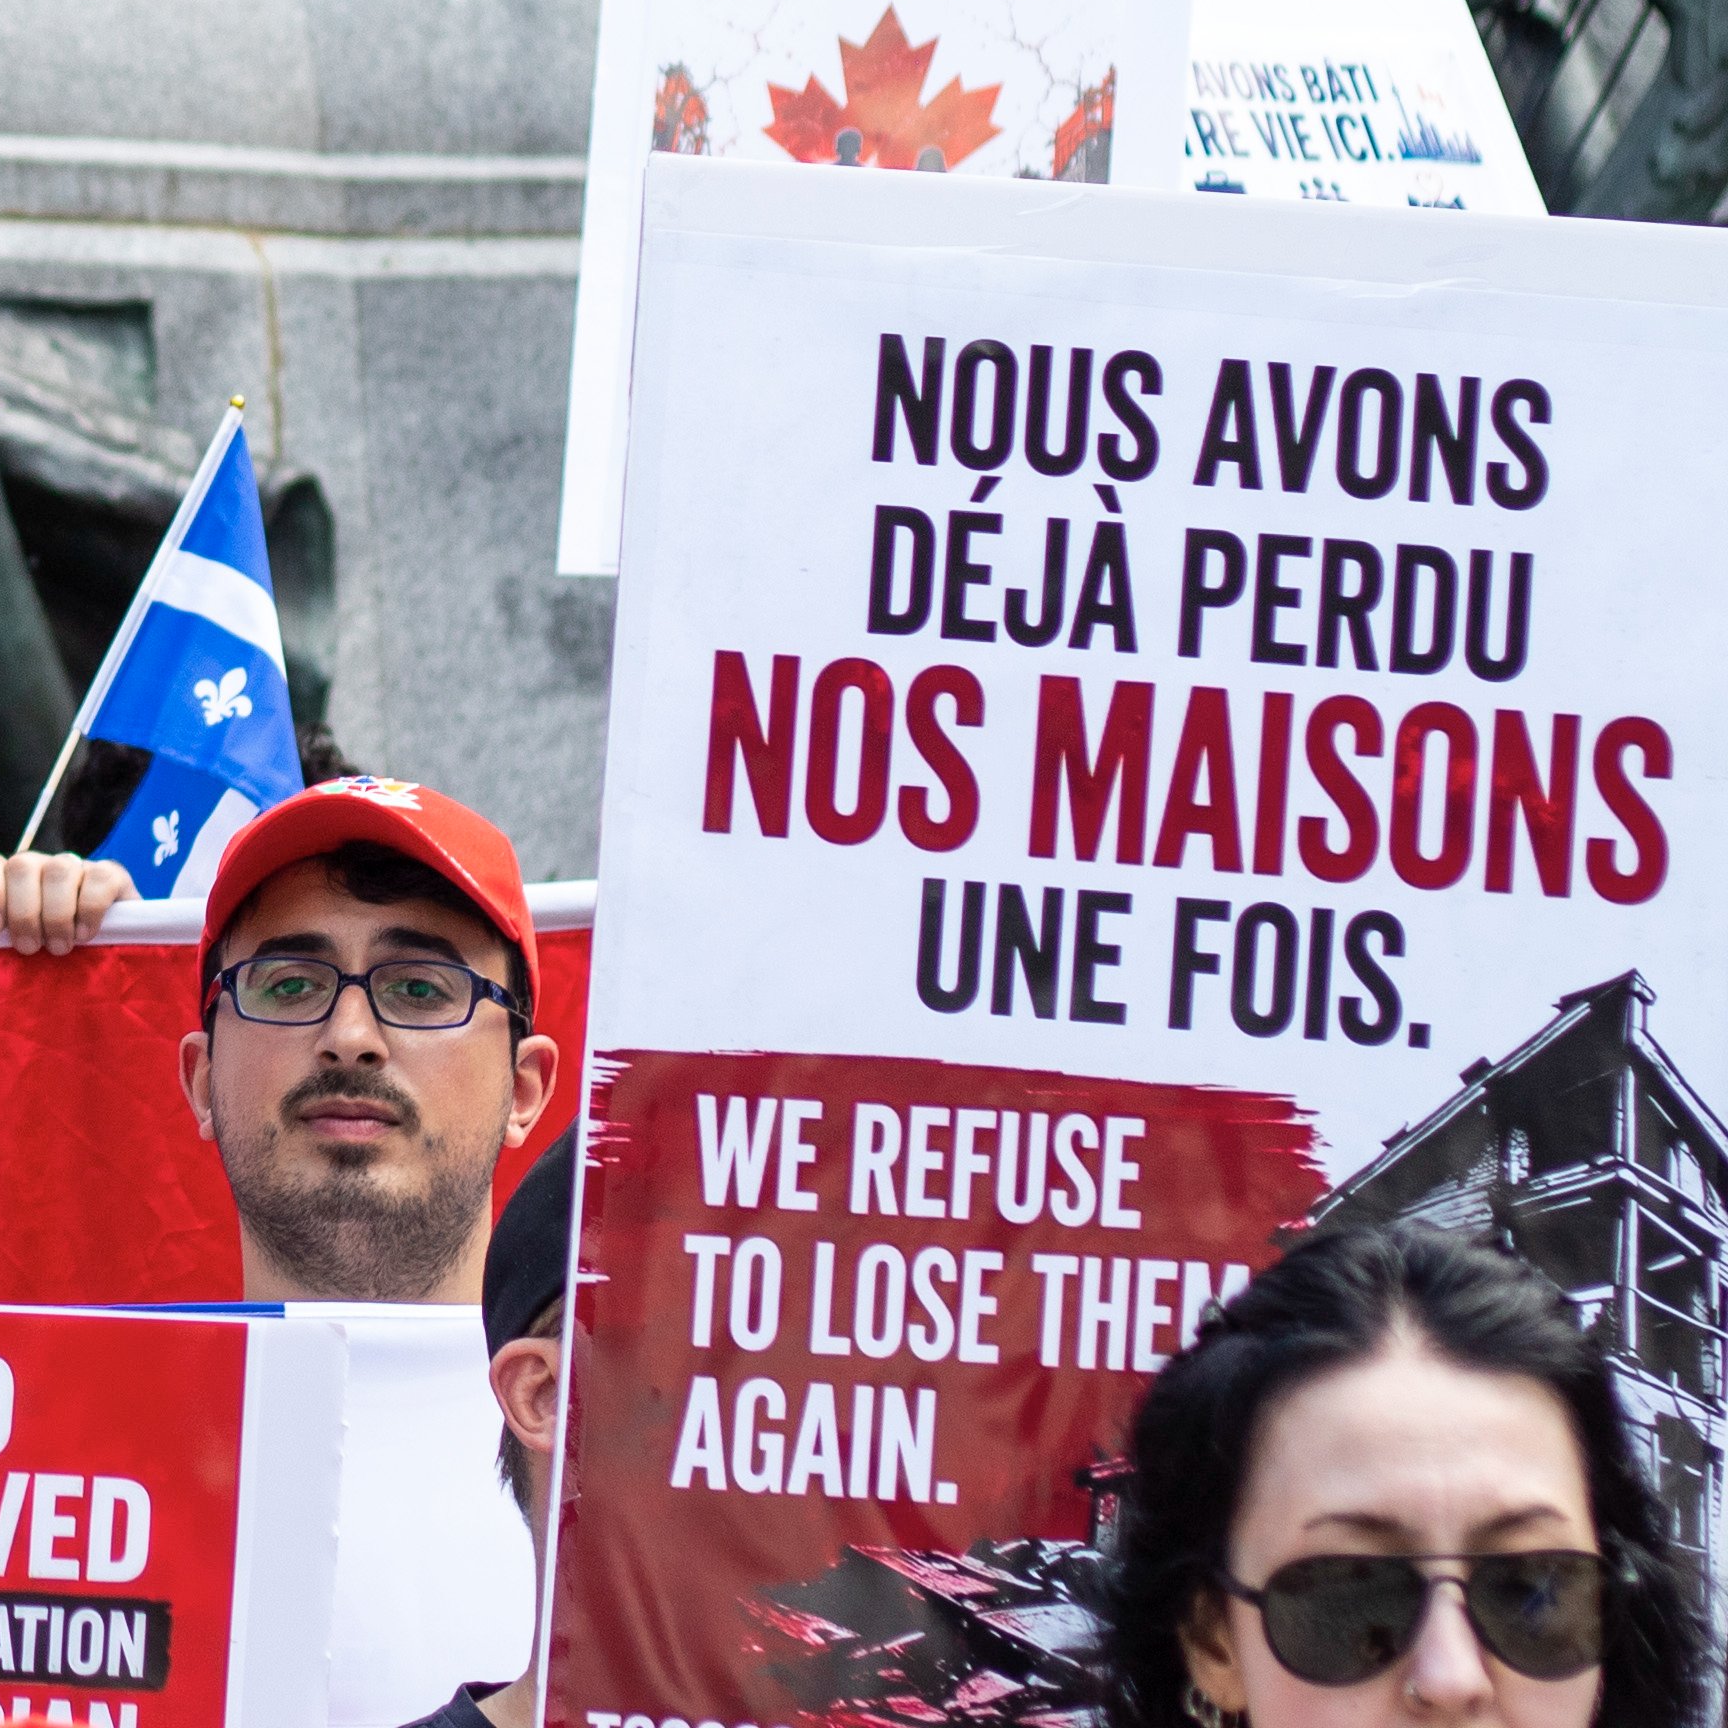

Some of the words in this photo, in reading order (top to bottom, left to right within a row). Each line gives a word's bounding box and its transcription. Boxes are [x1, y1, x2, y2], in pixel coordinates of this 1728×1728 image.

[1185, 110, 1248, 157] RE
[1251, 112, 1319, 161] VIE
[1321, 114, 1394, 163] ICI.
[1192, 61, 1297, 104] AVONS
[873, 334, 1162, 482] NOUS
[1194, 359, 1548, 510] AVONS
[868, 476, 1134, 652] DÉJÀ
[1179, 529, 1531, 681] PERDU
[703, 650, 984, 852] NOS
[1029, 674, 1674, 906] MAISONS
[918, 879, 1130, 1024] UNE
[1170, 898, 1427, 1047] FOIS.
[698, 1095, 822, 1210] WE
[851, 1104, 1144, 1228] REFUSE
[685, 1235, 781, 1351] TO
[811, 1242, 1002, 1363] LOSE
[671, 1377, 957, 1504] AGAIN.
